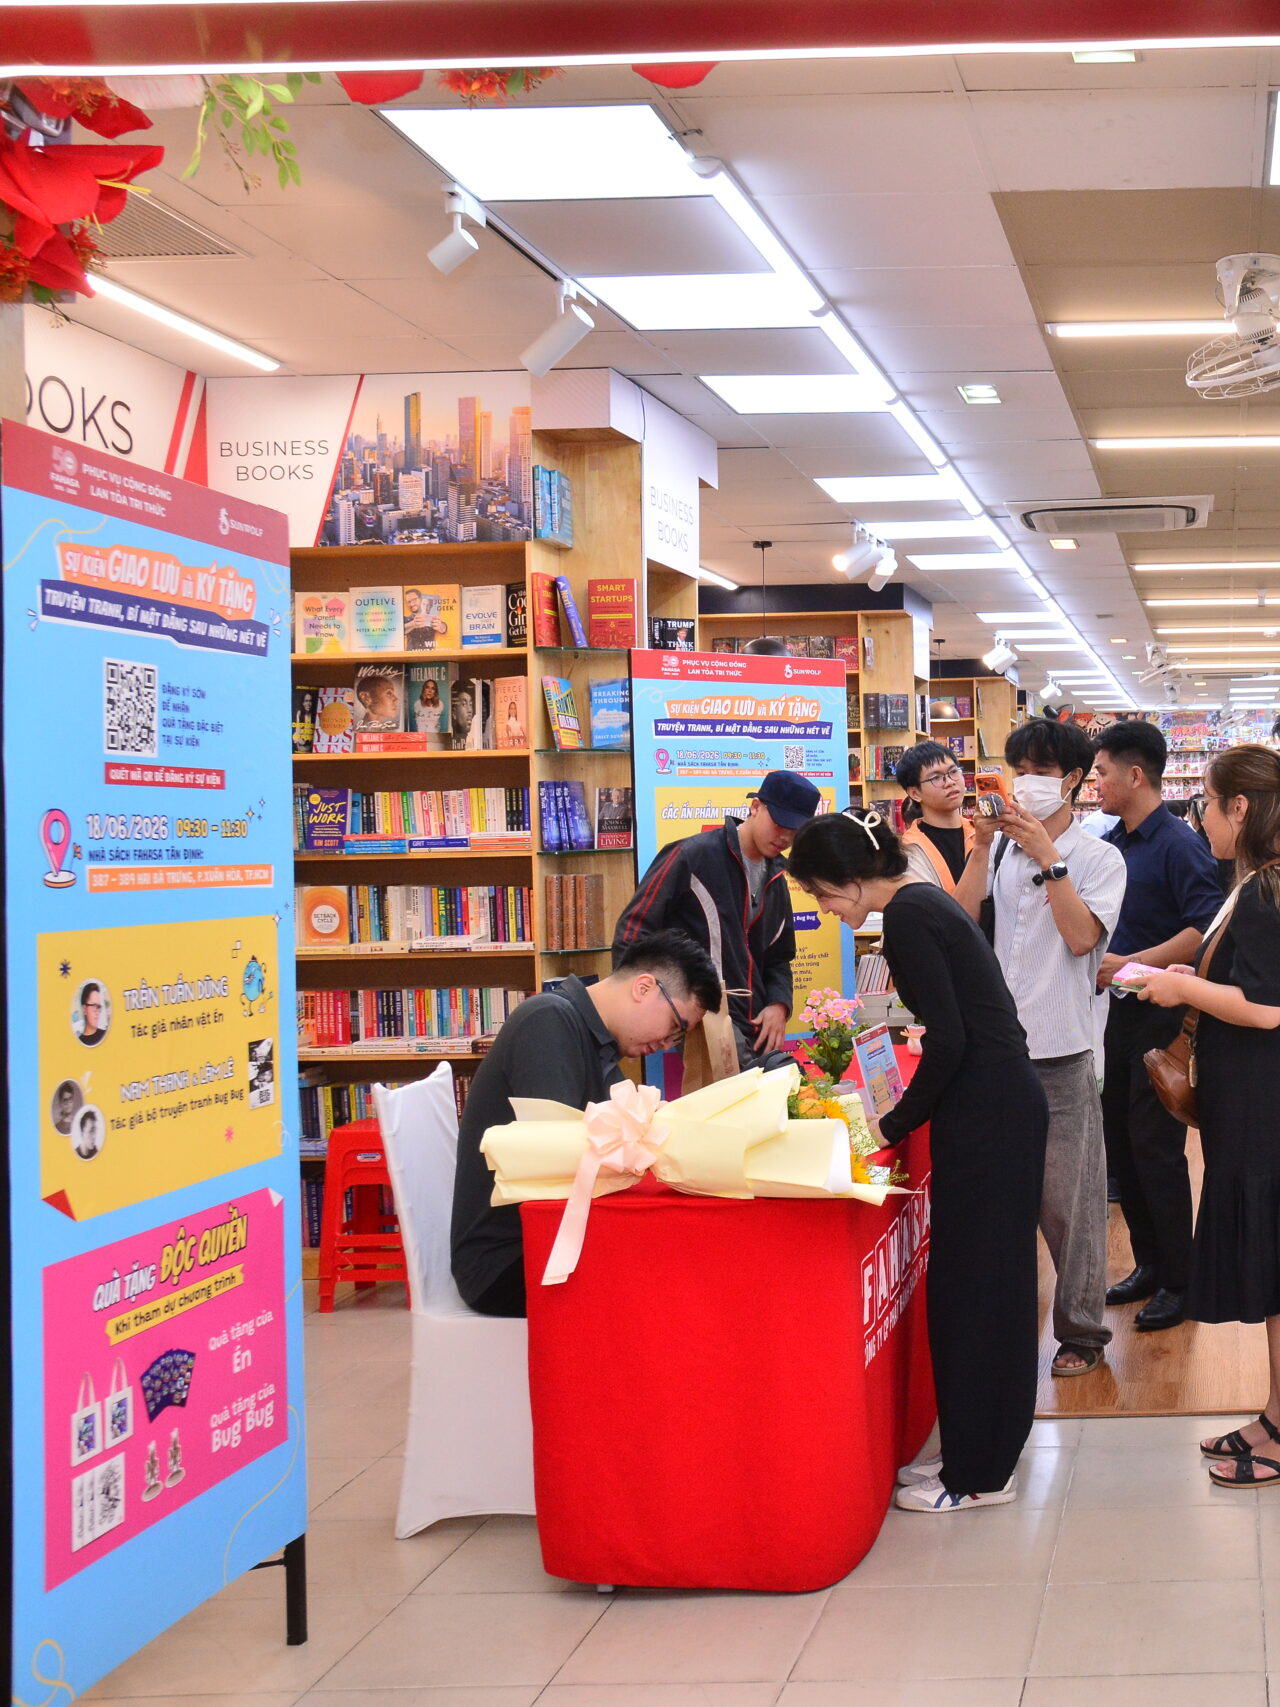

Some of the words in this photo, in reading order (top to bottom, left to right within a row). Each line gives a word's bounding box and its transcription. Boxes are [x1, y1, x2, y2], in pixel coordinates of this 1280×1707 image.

[25, 372, 133, 455] OKS
[220, 440, 329, 457] BUSINESS
[82, 462, 108, 481] PHỤC
[236, 464, 314, 481] BOOKS
[89, 485, 109, 500] LAN
[129, 497, 143, 510] TRI
[651, 486, 694, 525] BUSINESS
[229, 518, 263, 536] SUNWOLF
[658, 521, 689, 553] BOOKS
[65, 550, 82, 577] SỰ
[82, 550, 108, 582] KIỆN
[108, 550, 150, 588] GIAO
[153, 558, 181, 596] LƯU
[196, 560, 218, 603] KÝ
[219, 570, 255, 616] TẶNG
[596, 584, 626, 592] SMART
[355, 597, 396, 607] OUTLIVE
[590, 595, 633, 603] STARTUPS
[44, 588, 86, 614] TRUYỆN
[88, 597, 124, 622] TRANH,
[127, 604, 139, 622] BÍ
[189, 620, 208, 636] SAU
[208, 621, 238, 643] NHỮNG
[239, 628, 256, 646] NÉT
[466, 611, 497, 620] EVOLVE
[666, 620, 694, 629] TRUMP
[469, 623, 495, 631] BRAIN
[357, 665, 404, 679] Worthy
[682, 659, 700, 667] PHỤC
[711, 660, 728, 668] CỘNG
[729, 660, 747, 668] ĐỒNG
[793, 668, 822, 676] SUNWOLF
[410, 667, 439, 681] MELANIE
[440, 666, 446, 681] C
[726, 669, 743, 677] THỨC
[593, 690, 629, 698] BREAKING
[670, 703, 680, 716] SỰ
[682, 700, 700, 717] KIỆN
[701, 698, 732, 715] GIAO
[734, 697, 756, 716] LƯU
[769, 693, 787, 717] KÝ
[788, 696, 818, 721] TẶNG
[657, 721, 686, 734] TRUYỆN
[687, 723, 714, 734] TRANH,
[716, 723, 726, 733] BÍ
[725, 724, 742, 735] MẬT
[742, 721, 763, 734] ĐẰNG
[764, 725, 779, 734] SAU
[780, 724, 805, 735] NHỮNG
[806, 725, 820, 735] NÉT
[821, 725, 832, 736] VẼ
[723, 752, 742, 760] 09:30
[313, 801, 347, 814] JUST
[661, 803, 680, 819] CÁC
[681, 801, 693, 819] ẤN
[694, 799, 719, 819] PHẨM
[86, 813, 169, 840] 18/06/2026
[175, 817, 209, 838] 09:30
[220, 818, 248, 839] 11:30
[309, 813, 346, 824] WORK
[314, 839, 323, 847] KIM
[324, 839, 339, 847] SCOTT
[88, 848, 106, 862] NHÀ
[108, 847, 131, 861] SÁCH
[133, 848, 163, 861] FAHASA
[165, 846, 181, 860] TÂN
[123, 978, 160, 1011] TRẦN
[161, 973, 195, 1005] TUẤN
[197, 975, 229, 1000] DŨNG
[130, 1020, 148, 1038] Tác
[151, 1014, 168, 1038] giả
[169, 1015, 194, 1031] nhân
[195, 1011, 211, 1029] vật
[213, 1009, 224, 1024] Én
[120, 1079, 151, 1103] NAM
[151, 1069, 190, 1096] THANH
[110, 1117, 126, 1131] Tác
[146, 1107, 157, 1123] bộ
[159, 1100, 188, 1119] truyện
[189, 1094, 212, 1110] tranh
[214, 1091, 229, 1105] Bug
[230, 1088, 245, 1101] Bug
[92, 1268, 121, 1313] QUÀ
[123, 1260, 157, 1303] TẶNG
[159, 1225, 197, 1286] ĐỘC
[198, 1203, 249, 1267] QUYỀN
[864, 1184, 931, 1327] FAHASA
[114, 1317, 131, 1335] Khi
[133, 1306, 162, 1327] tham
[163, 1301, 176, 1317] dự
[178, 1283, 213, 1308] chương
[214, 1272, 236, 1292] trình
[208, 1329, 229, 1351] Quà
[230, 1319, 255, 1341] tặng
[255, 1309, 274, 1328] của
[232, 1345, 252, 1375] Én
[210, 1409, 230, 1429] Quà
[231, 1391, 256, 1418] tặng
[257, 1381, 276, 1402] của
[211, 1416, 242, 1453] Bug
[245, 1401, 275, 1434] Bug
